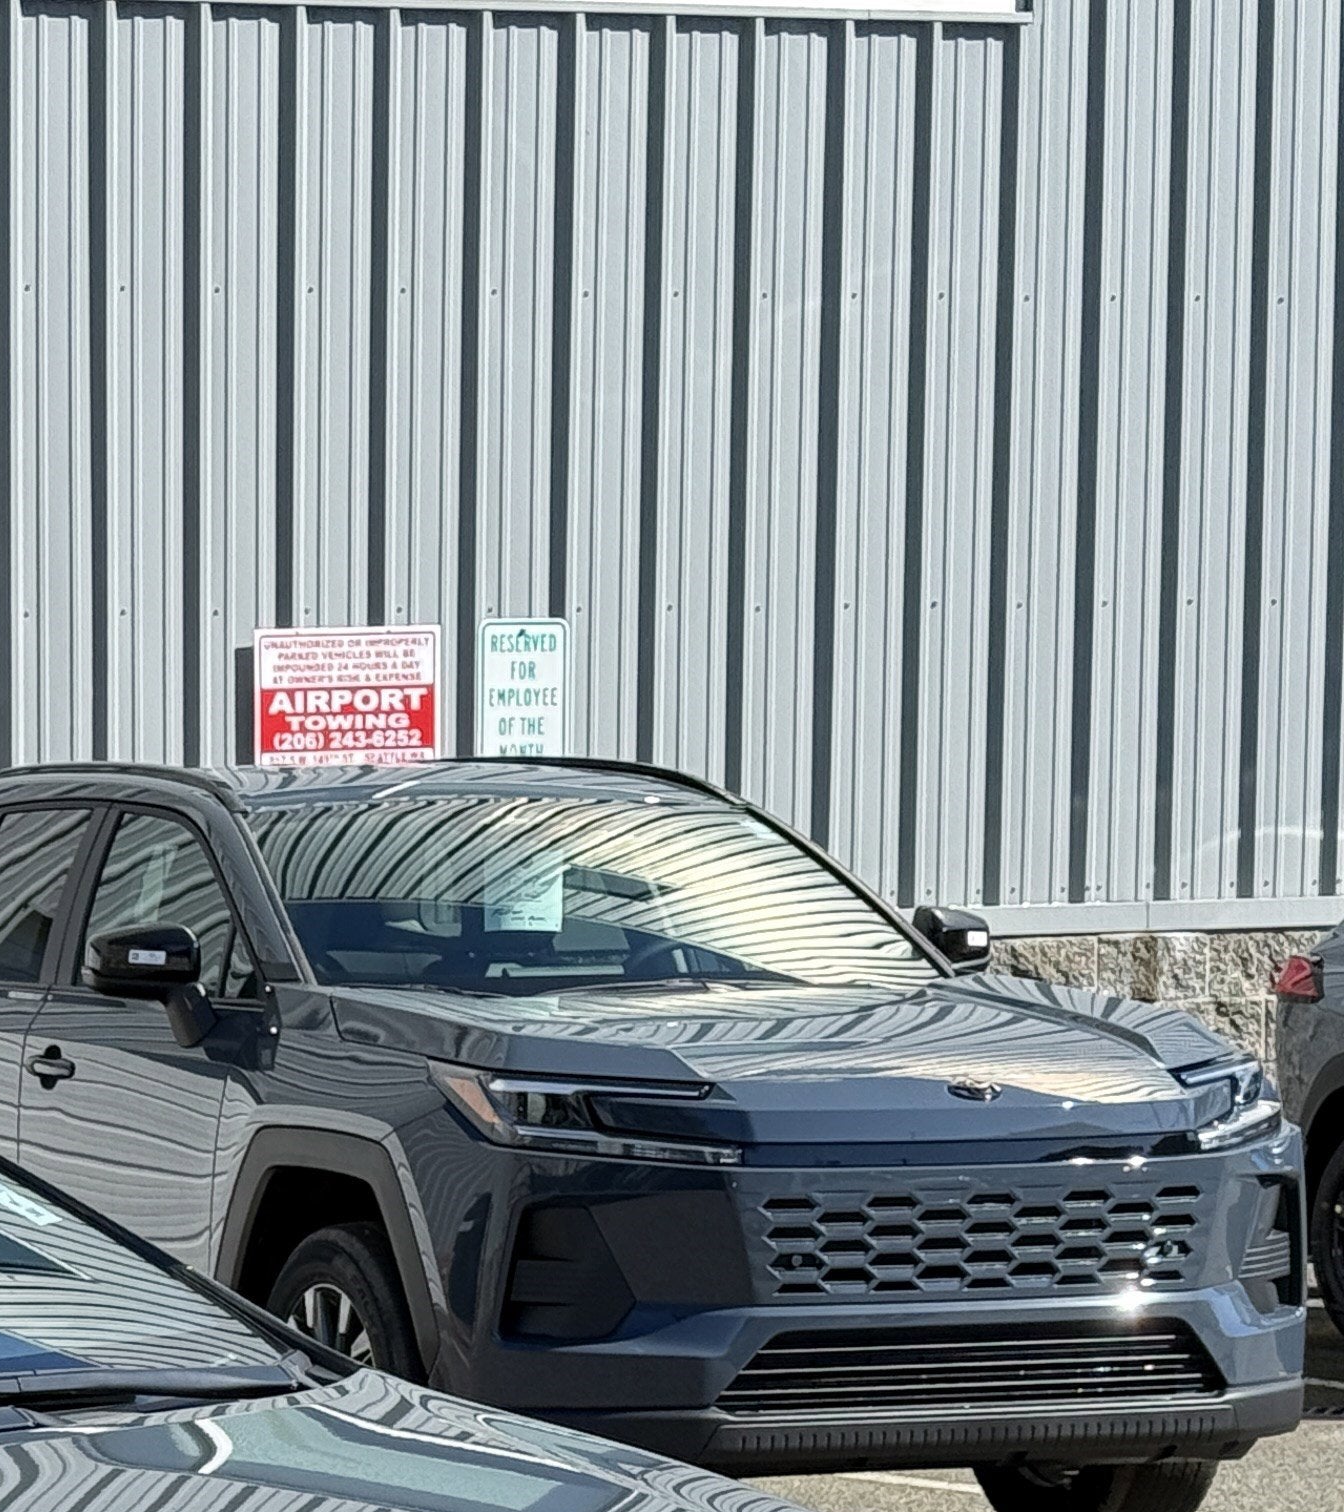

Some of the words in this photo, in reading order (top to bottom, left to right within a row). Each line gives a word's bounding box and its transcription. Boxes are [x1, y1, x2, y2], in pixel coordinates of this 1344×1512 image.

[490, 633, 557, 653] RESERVED
[510, 660, 537, 680] FOR
[269, 687, 429, 715] AIRPORT
[488, 686, 558, 707] EMPLOYEE
[285, 712, 411, 731] TOWING
[498, 717, 515, 736] OF
[519, 716, 545, 735] THE
[273, 732, 324, 750] (206)
[329, 730, 422, 748] 243-6252
